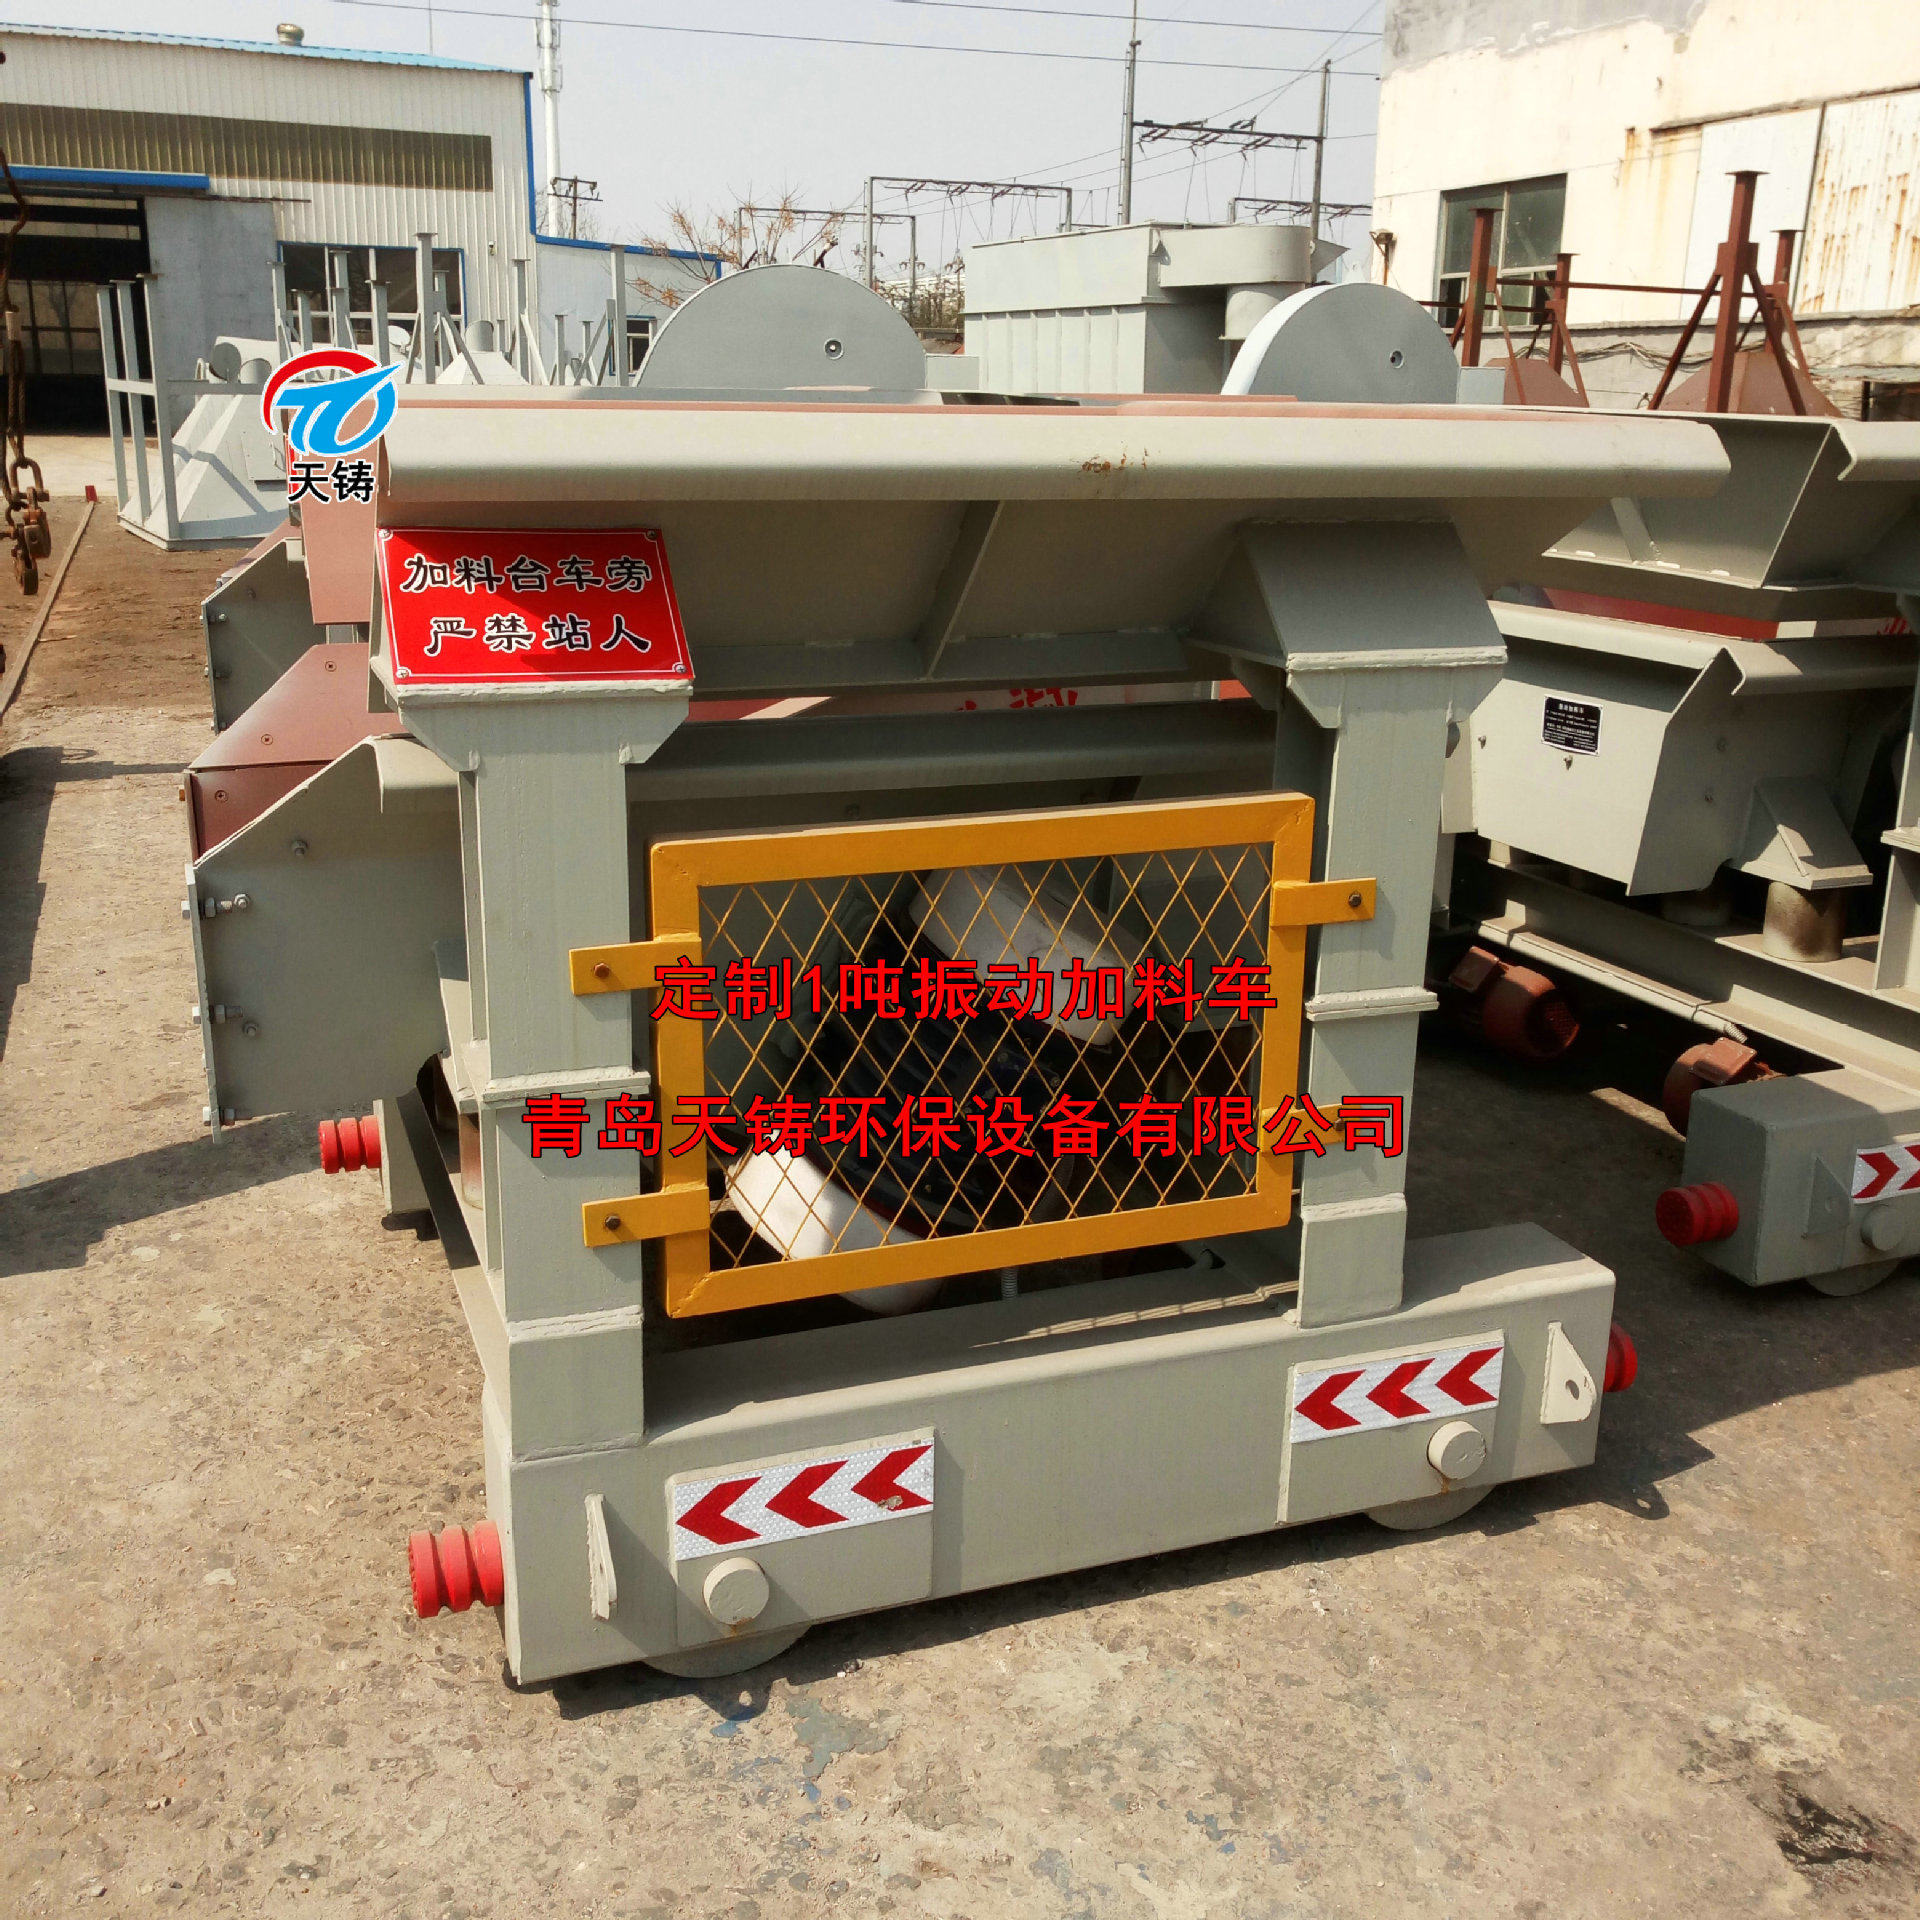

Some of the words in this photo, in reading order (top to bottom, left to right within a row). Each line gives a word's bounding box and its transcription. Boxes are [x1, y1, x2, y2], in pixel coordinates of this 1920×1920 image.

[400, 554, 652, 593] 加料台车旁
[424, 613, 651, 656] 严禁站人
